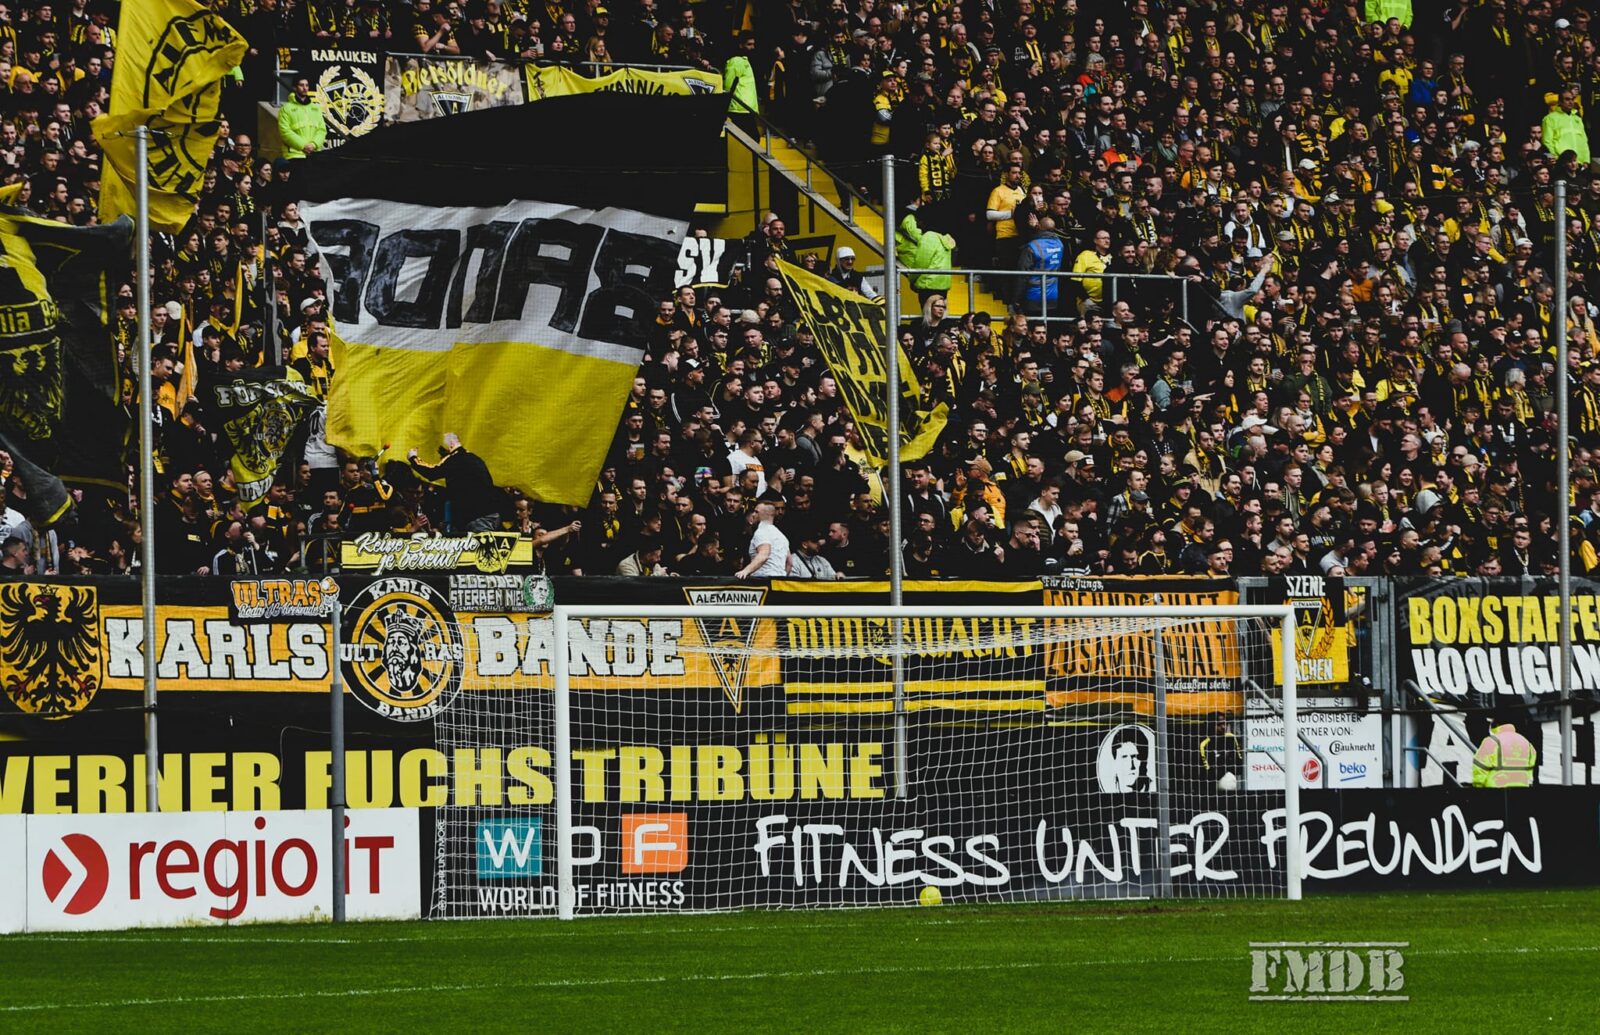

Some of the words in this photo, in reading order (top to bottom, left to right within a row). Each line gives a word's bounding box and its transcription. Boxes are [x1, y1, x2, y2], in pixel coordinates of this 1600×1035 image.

[312, 49, 377, 64] RABAUKEN
[674, 236, 725, 289] SV
[354, 532, 404, 554] Keine
[406, 532, 479, 553] Sekunde
[370, 551, 395, 576] je
[369, 580, 432, 600] KARLS
[449, 575, 523, 589] LEGENDEN
[1061, 577, 1075, 588] die
[1286, 574, 1326, 596] SZENE
[232, 581, 322, 608] ULTRAS
[450, 589, 502, 606] STERBEN
[696, 593, 757, 604] ALEMANNIA
[1408, 594, 1600, 645] BOXSTAFFE
[105, 618, 328, 679] KARLS
[474, 616, 685, 677] BANDE
[1296, 658, 1333, 681] ACHEN
[1411, 643, 1600, 695] HOOLIGAN
[377, 700, 439, 720] BANDE
[1271, 713, 1285, 723] SIN
[1331, 726, 1353, 737] VON:
[1335, 743, 1375, 752] Bauknecht
[305, 746, 554, 808] FUCHS
[571, 733, 884, 803] TRIBÜNE
[1251, 763, 1280, 771] SHAR
[1339, 762, 1367, 774] beko
[754, 814, 1011, 887] FITNESS
[1035, 812, 1238, 883] UNTER
[1260, 804, 1542, 880] FREUNDEN
[129, 816, 319, 919] regio
[479, 887, 556, 912] WORLD
[596, 882, 685, 906] FITNESS
